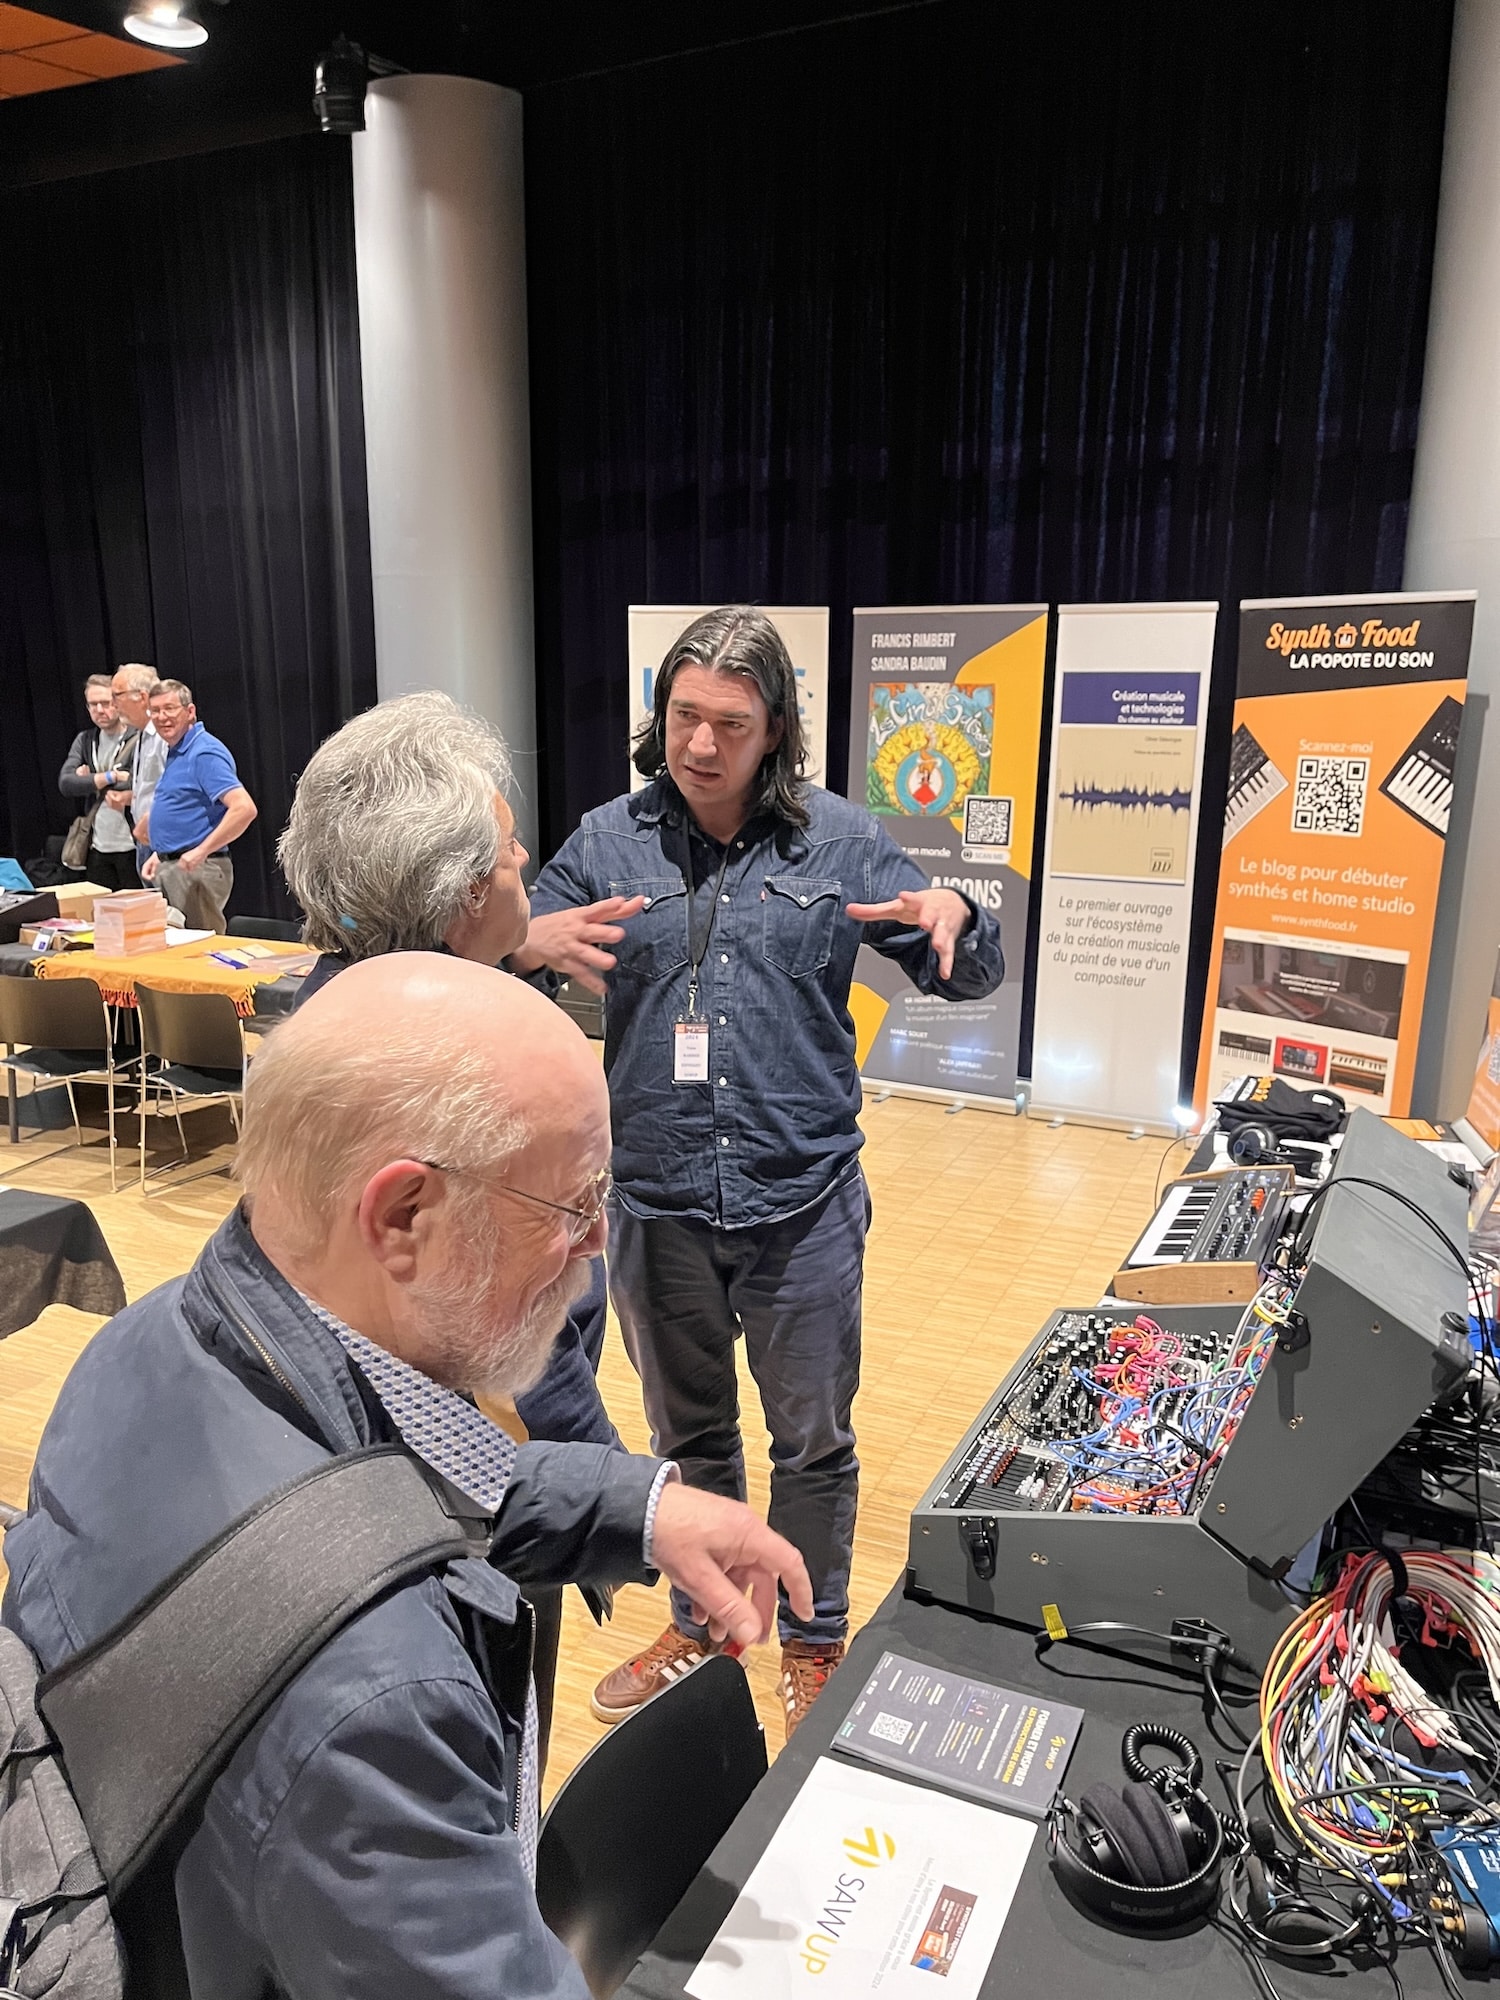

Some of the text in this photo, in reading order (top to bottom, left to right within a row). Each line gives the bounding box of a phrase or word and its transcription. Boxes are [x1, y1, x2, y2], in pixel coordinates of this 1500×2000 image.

[872, 633, 956, 648] FRANCIS RIMBERT
[1266, 620, 1420, 656] Synth Food
[871, 657, 946, 671] SANDRA BAUDIN
[1290, 651, 1434, 669] LA POPOTE DU SON
[1112, 690, 1185, 702] Création musicale
[1121, 703, 1184, 716] et technologies
[1118, 715, 1126, 723] Du
[1300, 739, 1373, 754] Scannez-moi
[920, 848, 950, 858] monde
[1240, 856, 1408, 889] Le blog pour débuter
[1059, 896, 1172, 917] Le premier ouvrage
[1229, 882, 1415, 916] synthés et home studio
[1066, 916, 1162, 933] sur l'écosystème
[1271, 914, 1357, 933] www.synthfood.fr
[1046, 931, 1180, 953] de la création musicale
[1053, 949, 1170, 971] du point de vue d'un
[1074, 971, 1146, 986] compositeur
[1029, 1707, 1038, 1717] LES
[1014, 1716, 1034, 1753] PRODUCTEURS
[1012, 1710, 1050, 1787] FORMER ET INSPIRER
[800, 1873, 864, 1974] SAWUP
